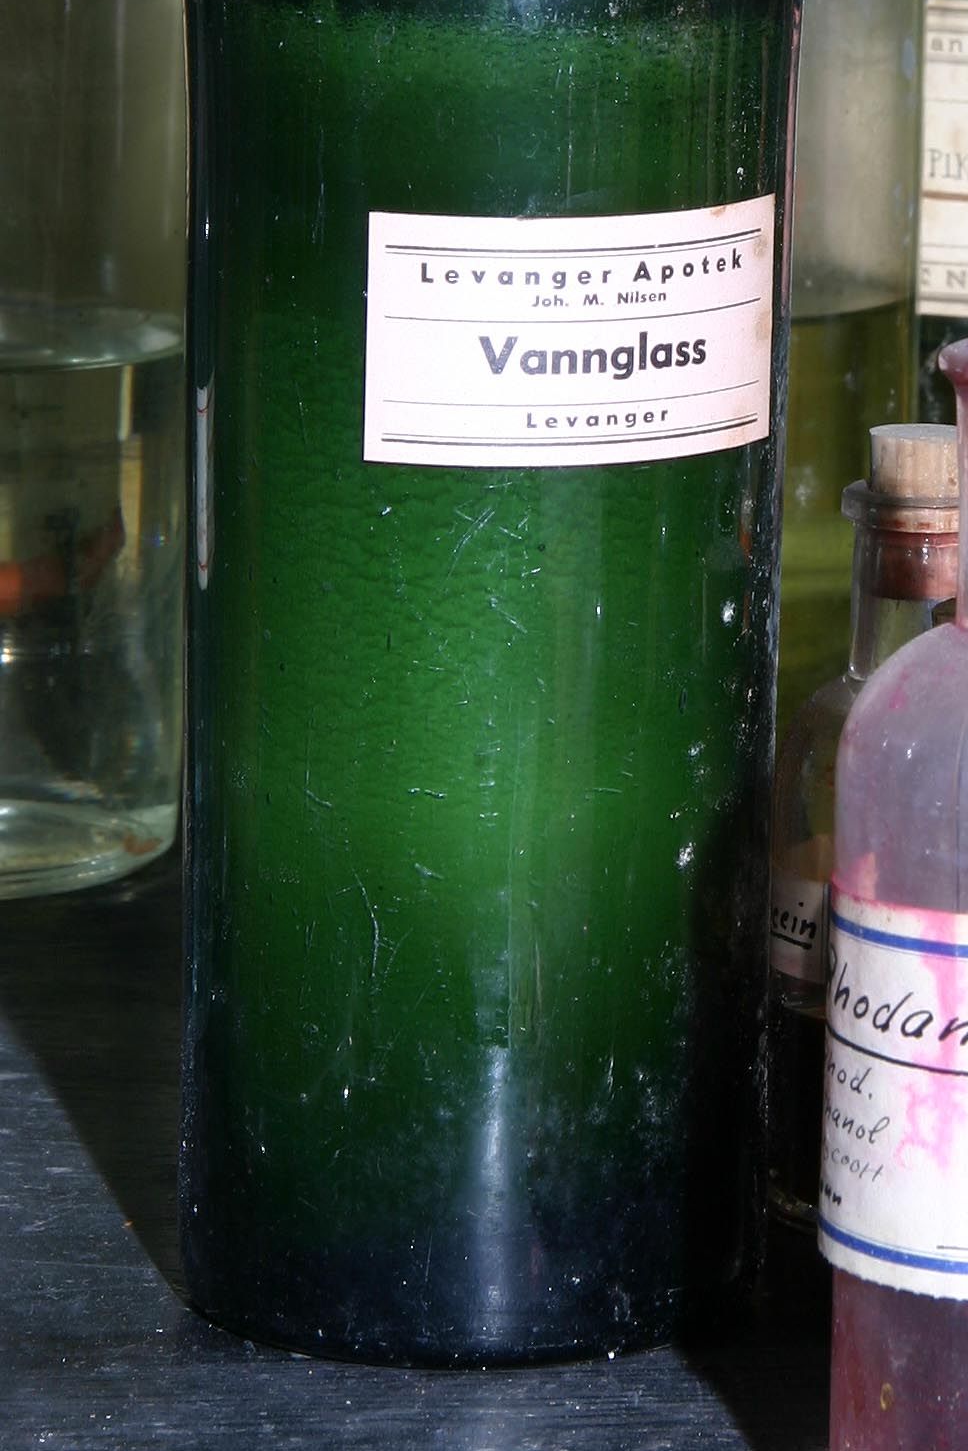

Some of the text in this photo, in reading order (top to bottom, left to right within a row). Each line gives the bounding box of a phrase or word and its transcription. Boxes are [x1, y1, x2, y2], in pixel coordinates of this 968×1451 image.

[420, 248, 742, 290] Levanger Apotek
[531, 290, 667, 308] Joh. M. Nilsen
[479, 331, 707, 380] Vannglass
[527, 407, 669, 428] Levanger
